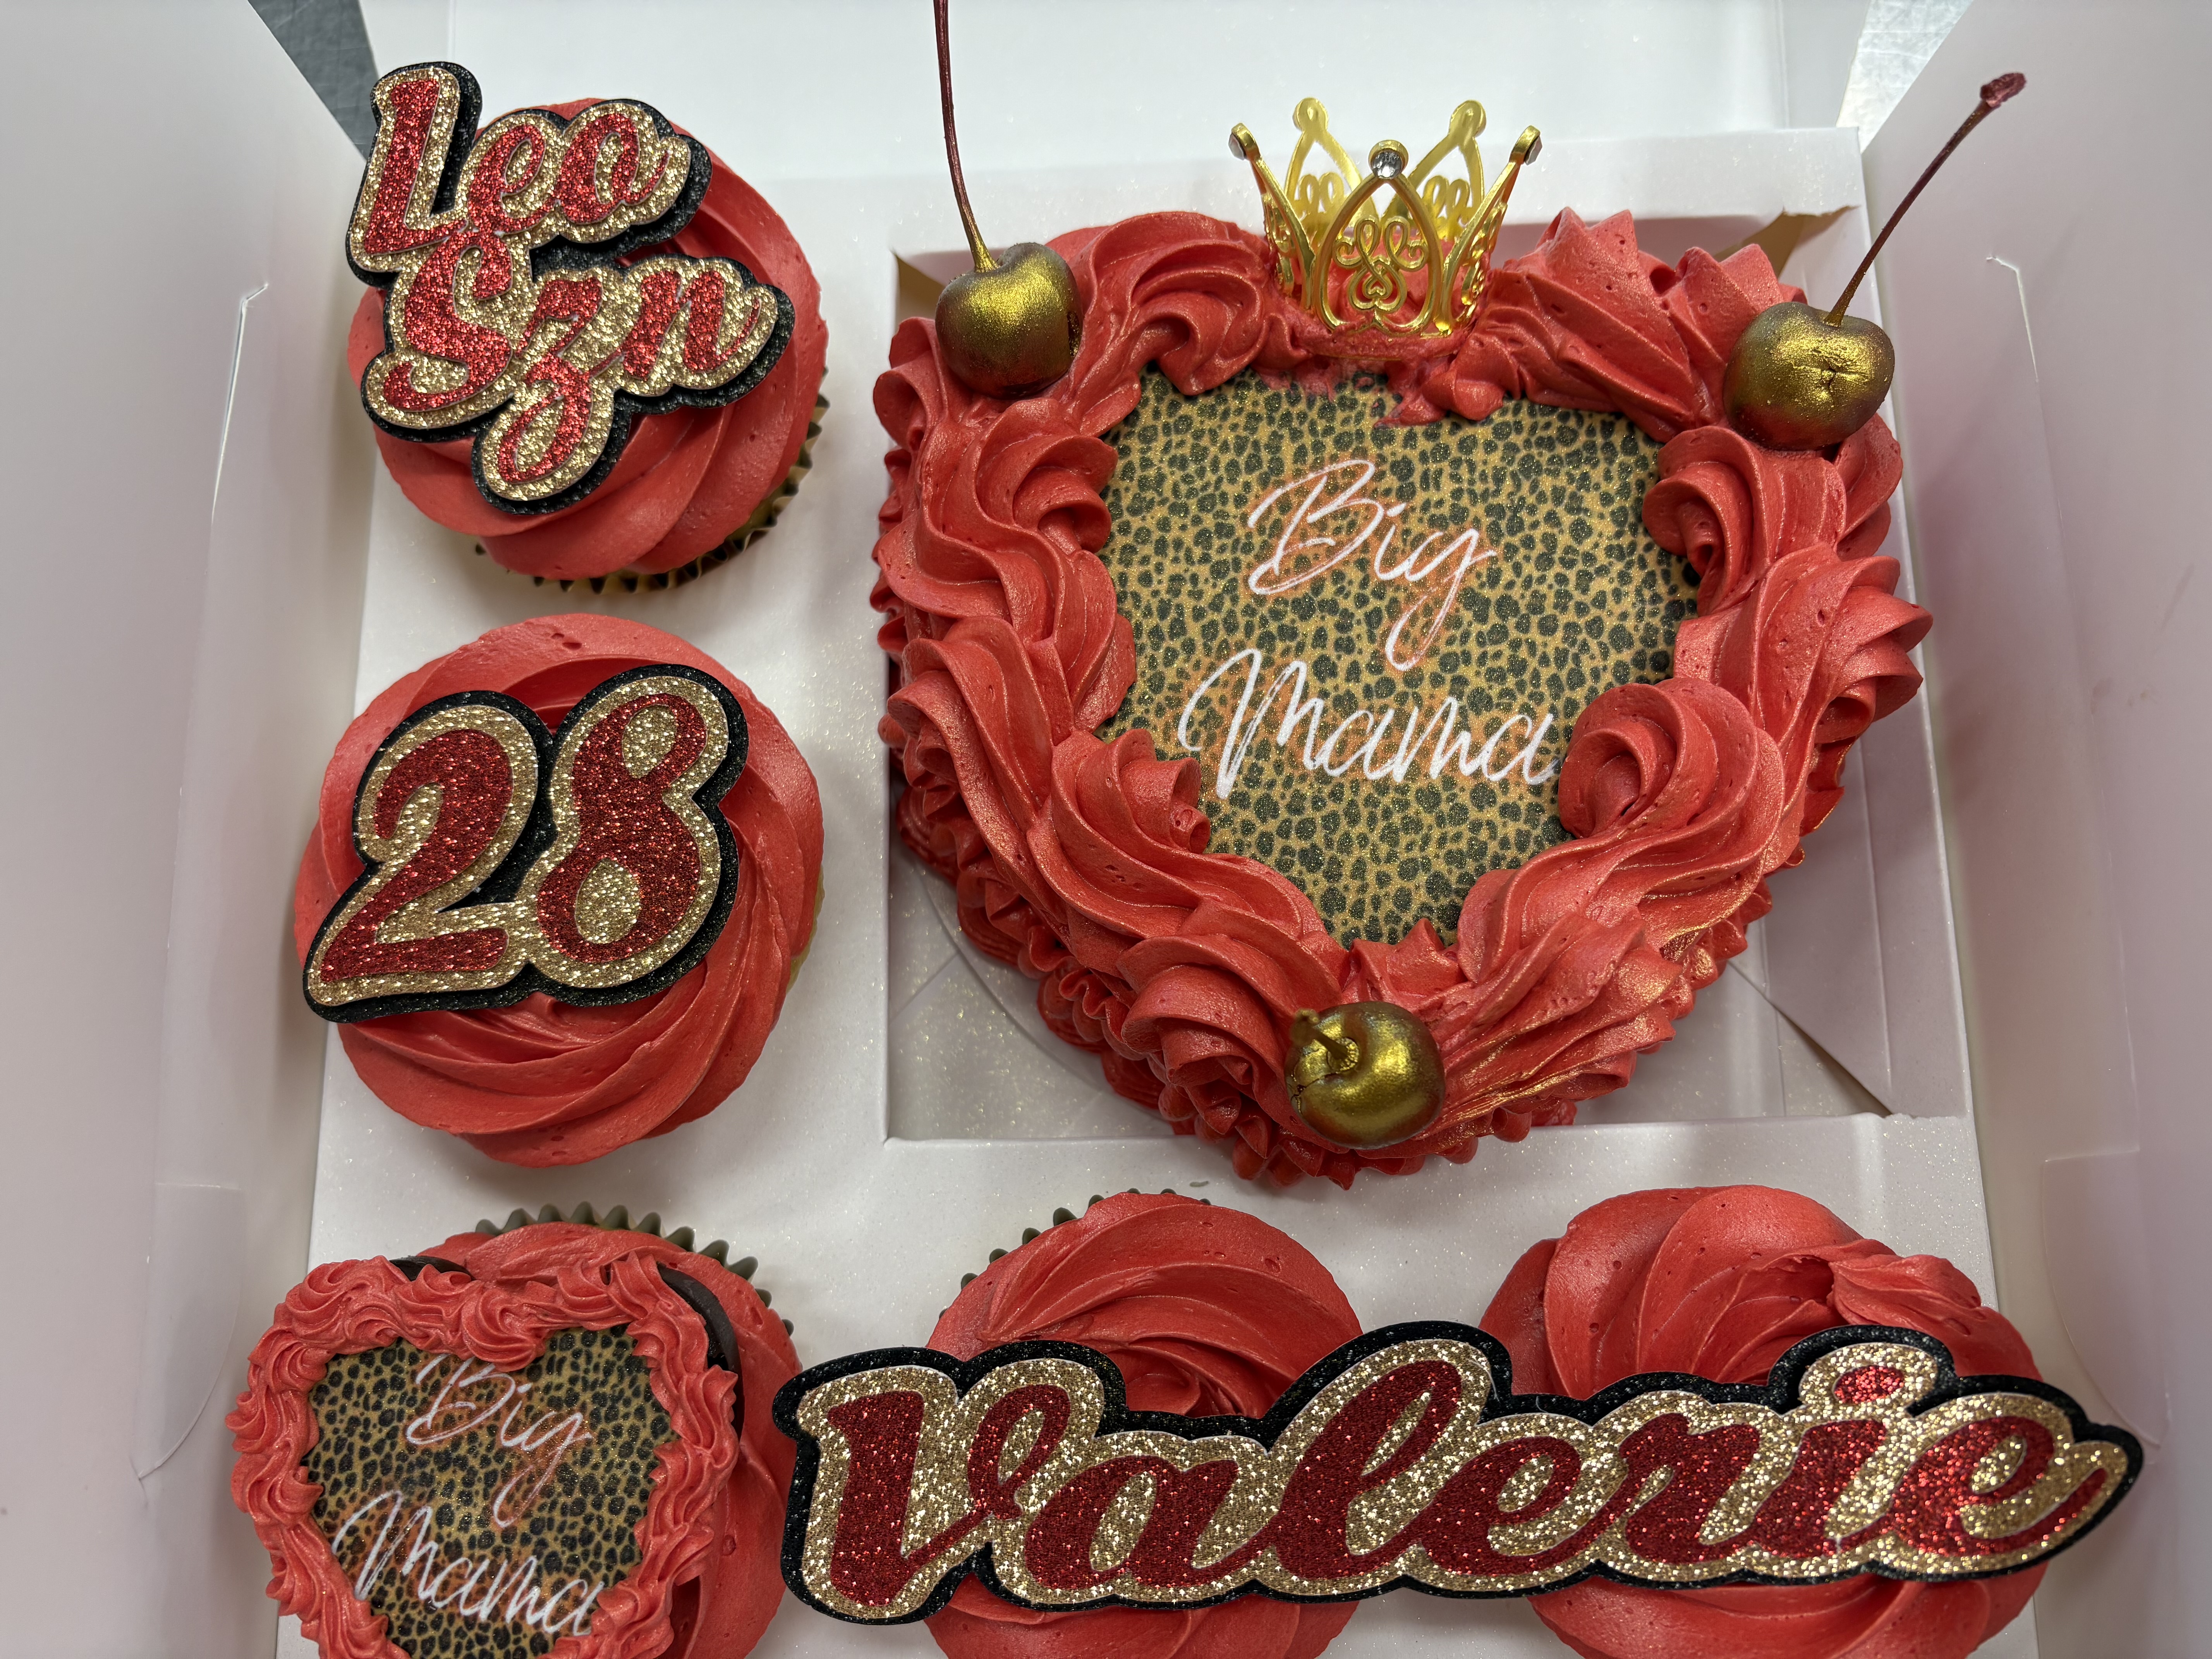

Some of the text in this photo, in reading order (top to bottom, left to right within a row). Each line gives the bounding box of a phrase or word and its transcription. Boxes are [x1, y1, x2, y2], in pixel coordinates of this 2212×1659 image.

[363, 76, 673, 256] Leo
[385, 230, 762, 485] Szn
[1247, 459, 1498, 671] Big
[1177, 648, 1559, 800] Mama
[319, 692, 709, 983] 28
[404, 1353, 592, 1528] Big
[825, 1358, 2109, 1606] Valerie
[331, 1489, 605, 1636] Mama
